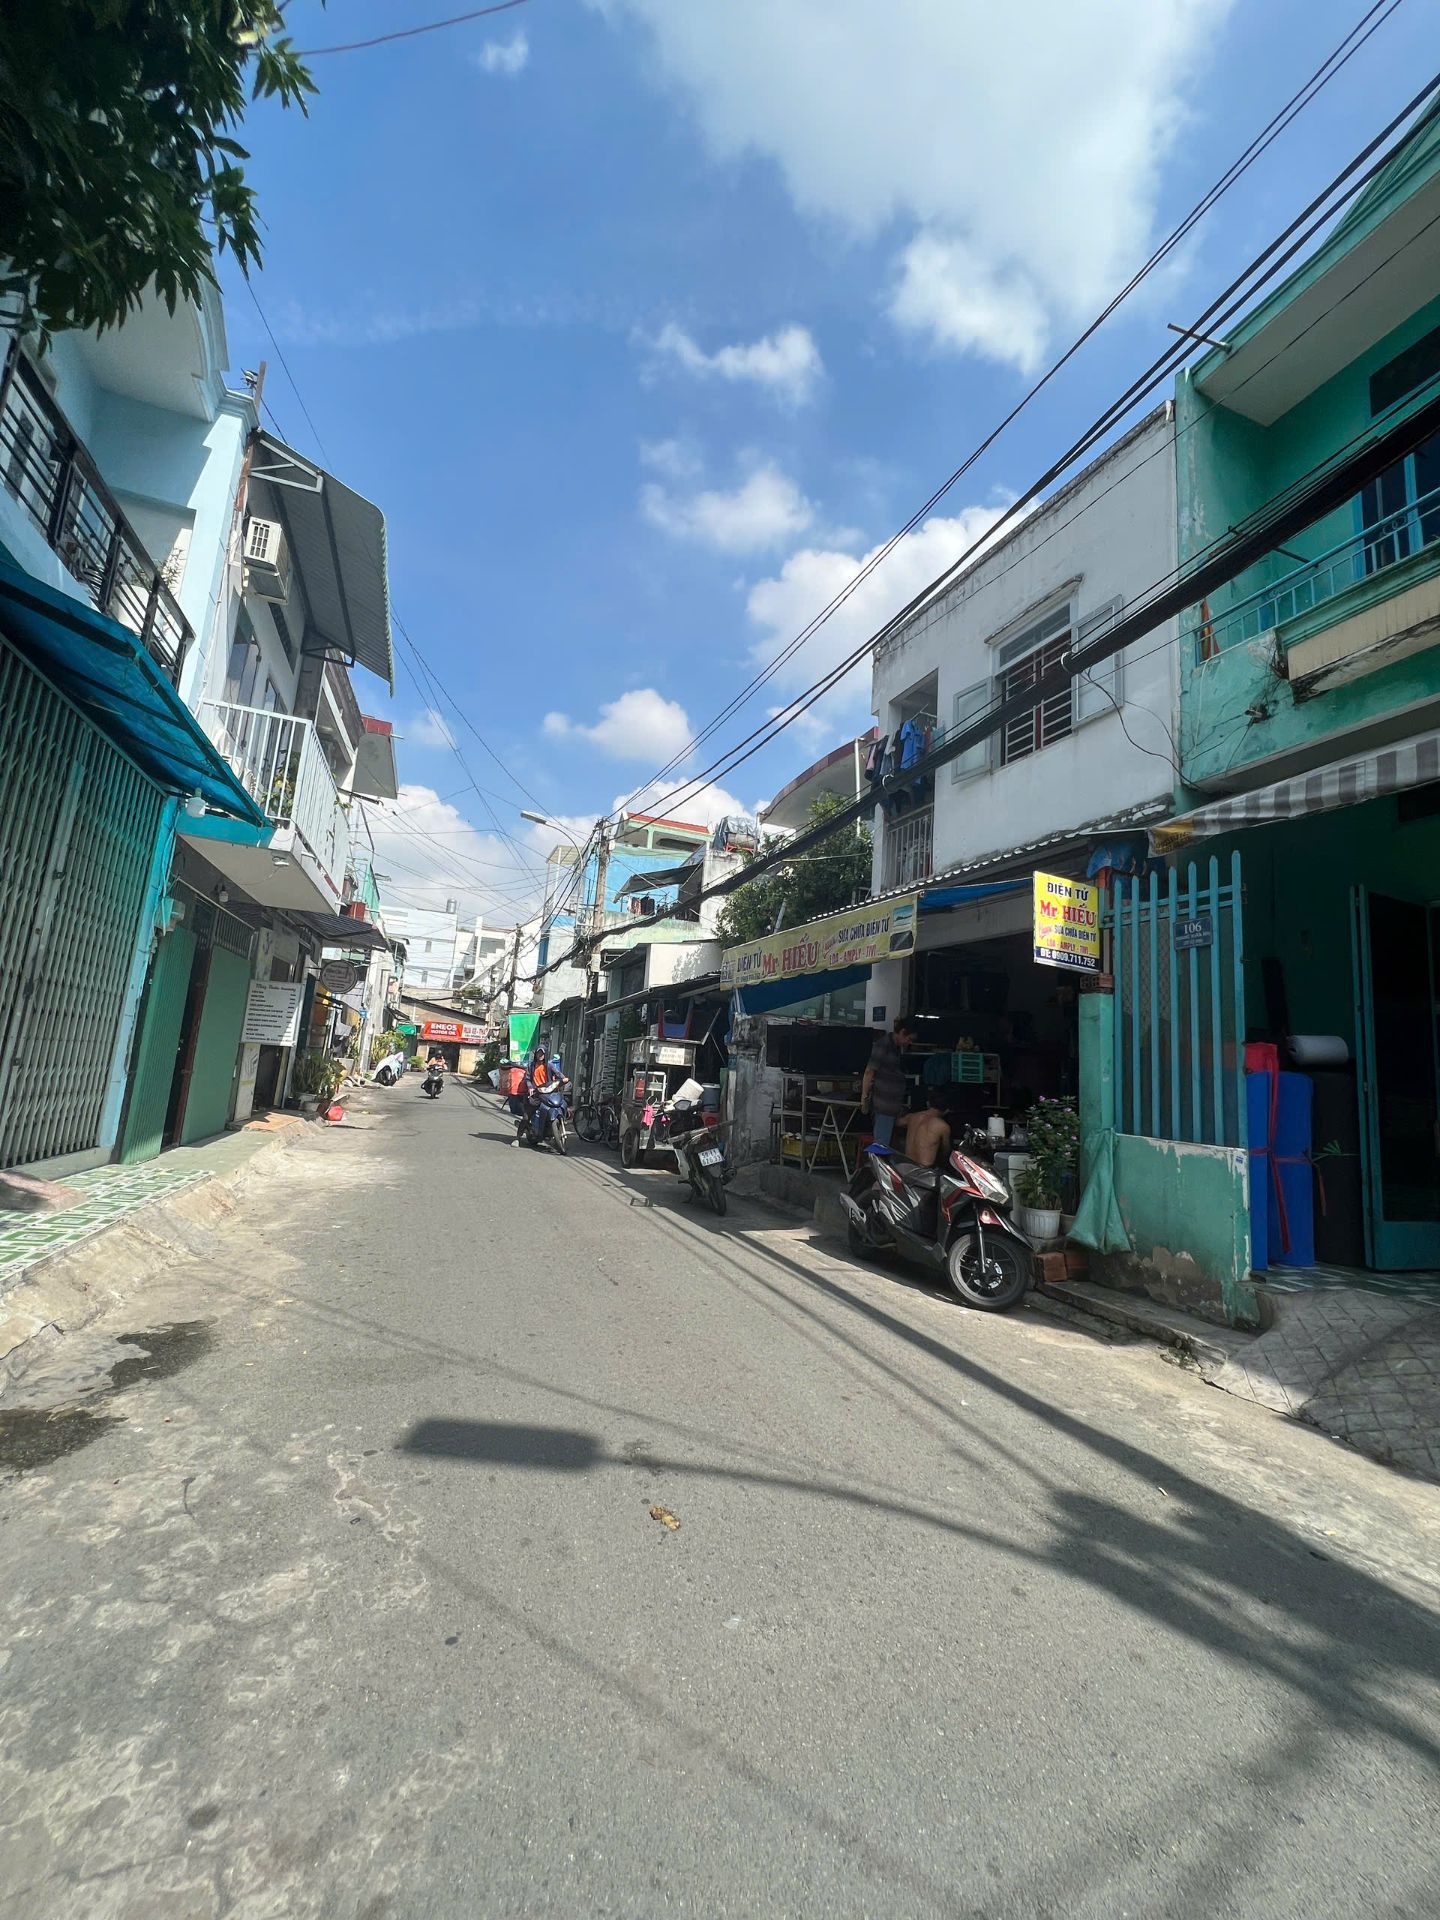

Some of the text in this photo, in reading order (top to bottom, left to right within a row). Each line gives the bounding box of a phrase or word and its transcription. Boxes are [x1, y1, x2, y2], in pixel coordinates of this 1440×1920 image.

[1047, 882, 1072, 898] ĐIỆN
[1040, 899, 1096, 927] Mr HIẾU
[1184, 921, 1202, 935] 106
[761, 953, 780, 978] Mr
[781, 933, 819, 972] HIẾU
[430, 1023, 458, 1031] ENEOS
